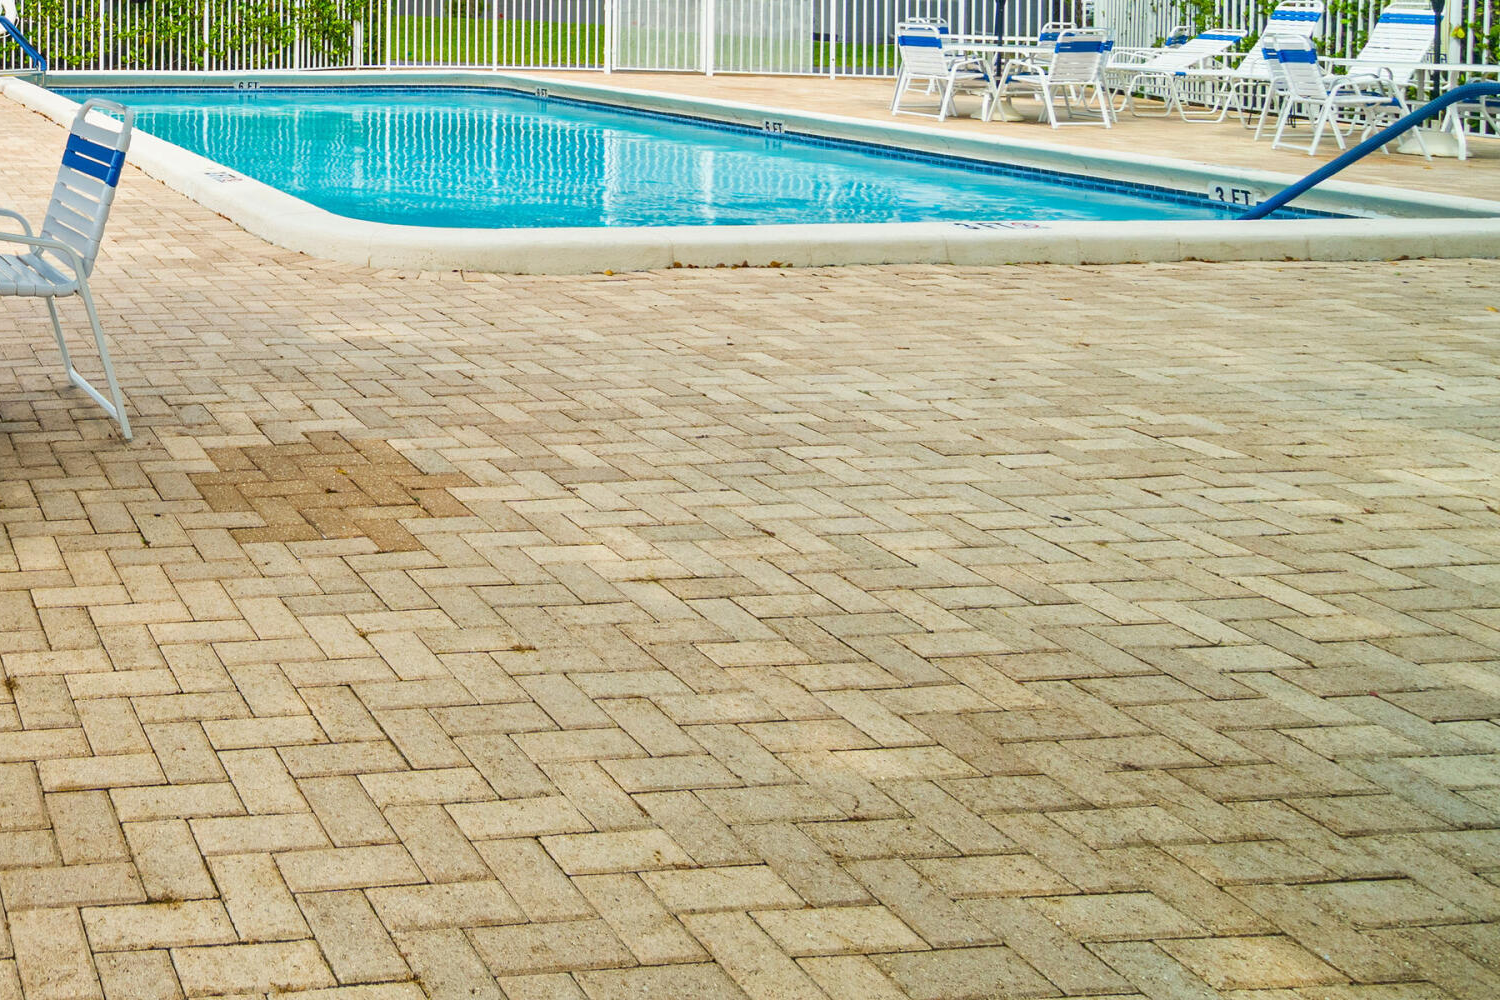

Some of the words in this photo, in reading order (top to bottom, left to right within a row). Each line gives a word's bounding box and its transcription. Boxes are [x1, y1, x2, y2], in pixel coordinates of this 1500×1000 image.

[247, 81, 260, 89] FT
[772, 122, 783, 133] FT
[1215, 186, 1225, 202] 3
[1231, 188, 1252, 205] FT
